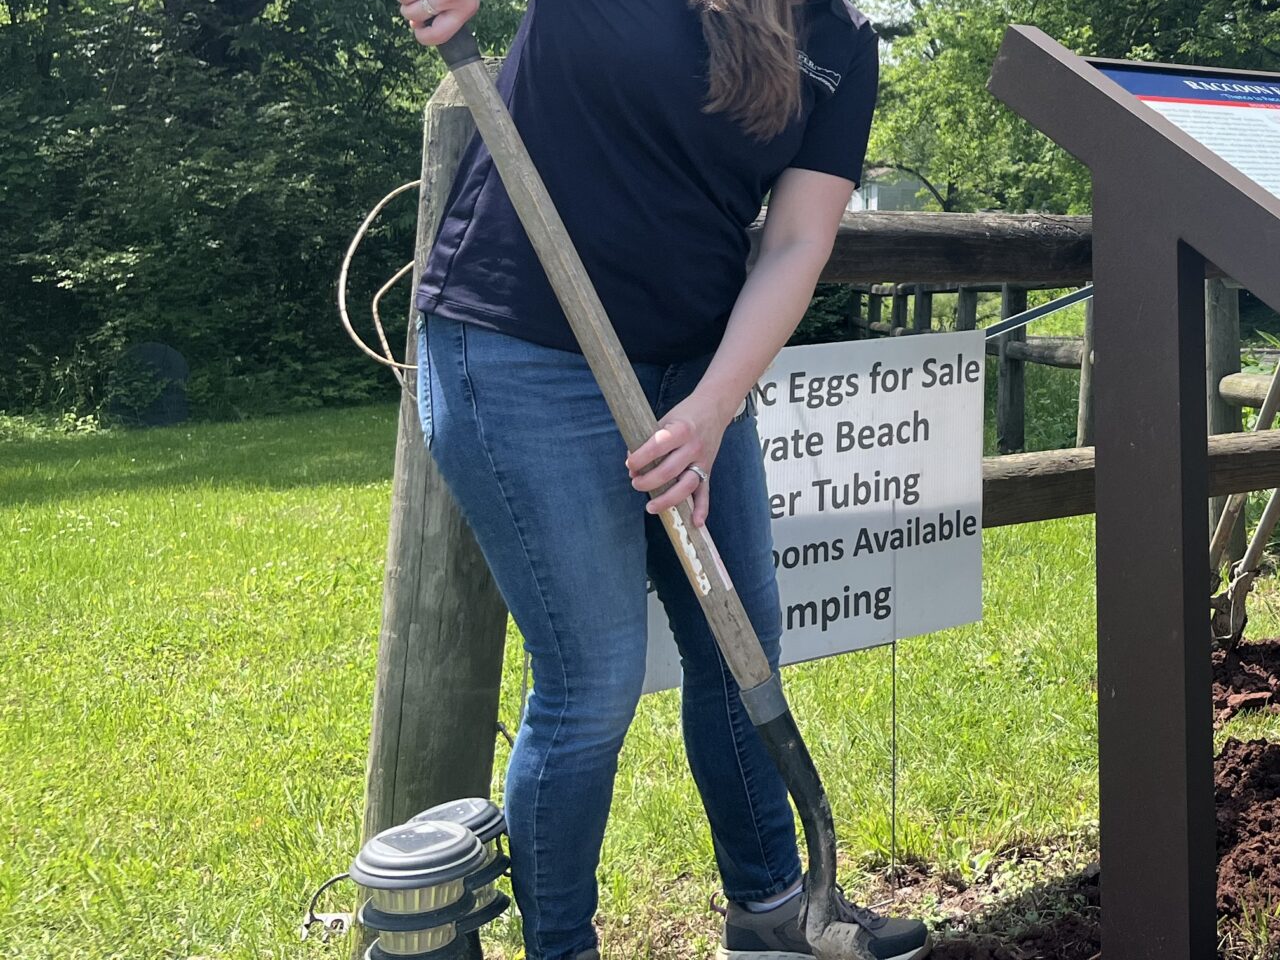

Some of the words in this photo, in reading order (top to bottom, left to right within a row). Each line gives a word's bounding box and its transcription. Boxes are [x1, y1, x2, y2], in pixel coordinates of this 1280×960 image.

[1183, 80, 1274, 96] RACCOON
[788, 371, 860, 409] Eggs
[869, 361, 913, 394] for
[921, 353, 980, 389] Sale
[836, 410, 930, 453] Beach
[769, 490, 802, 519] er
[812, 470, 921, 511] Tubing
[852, 509, 977, 557] Available
[780, 585, 892, 631] mping
